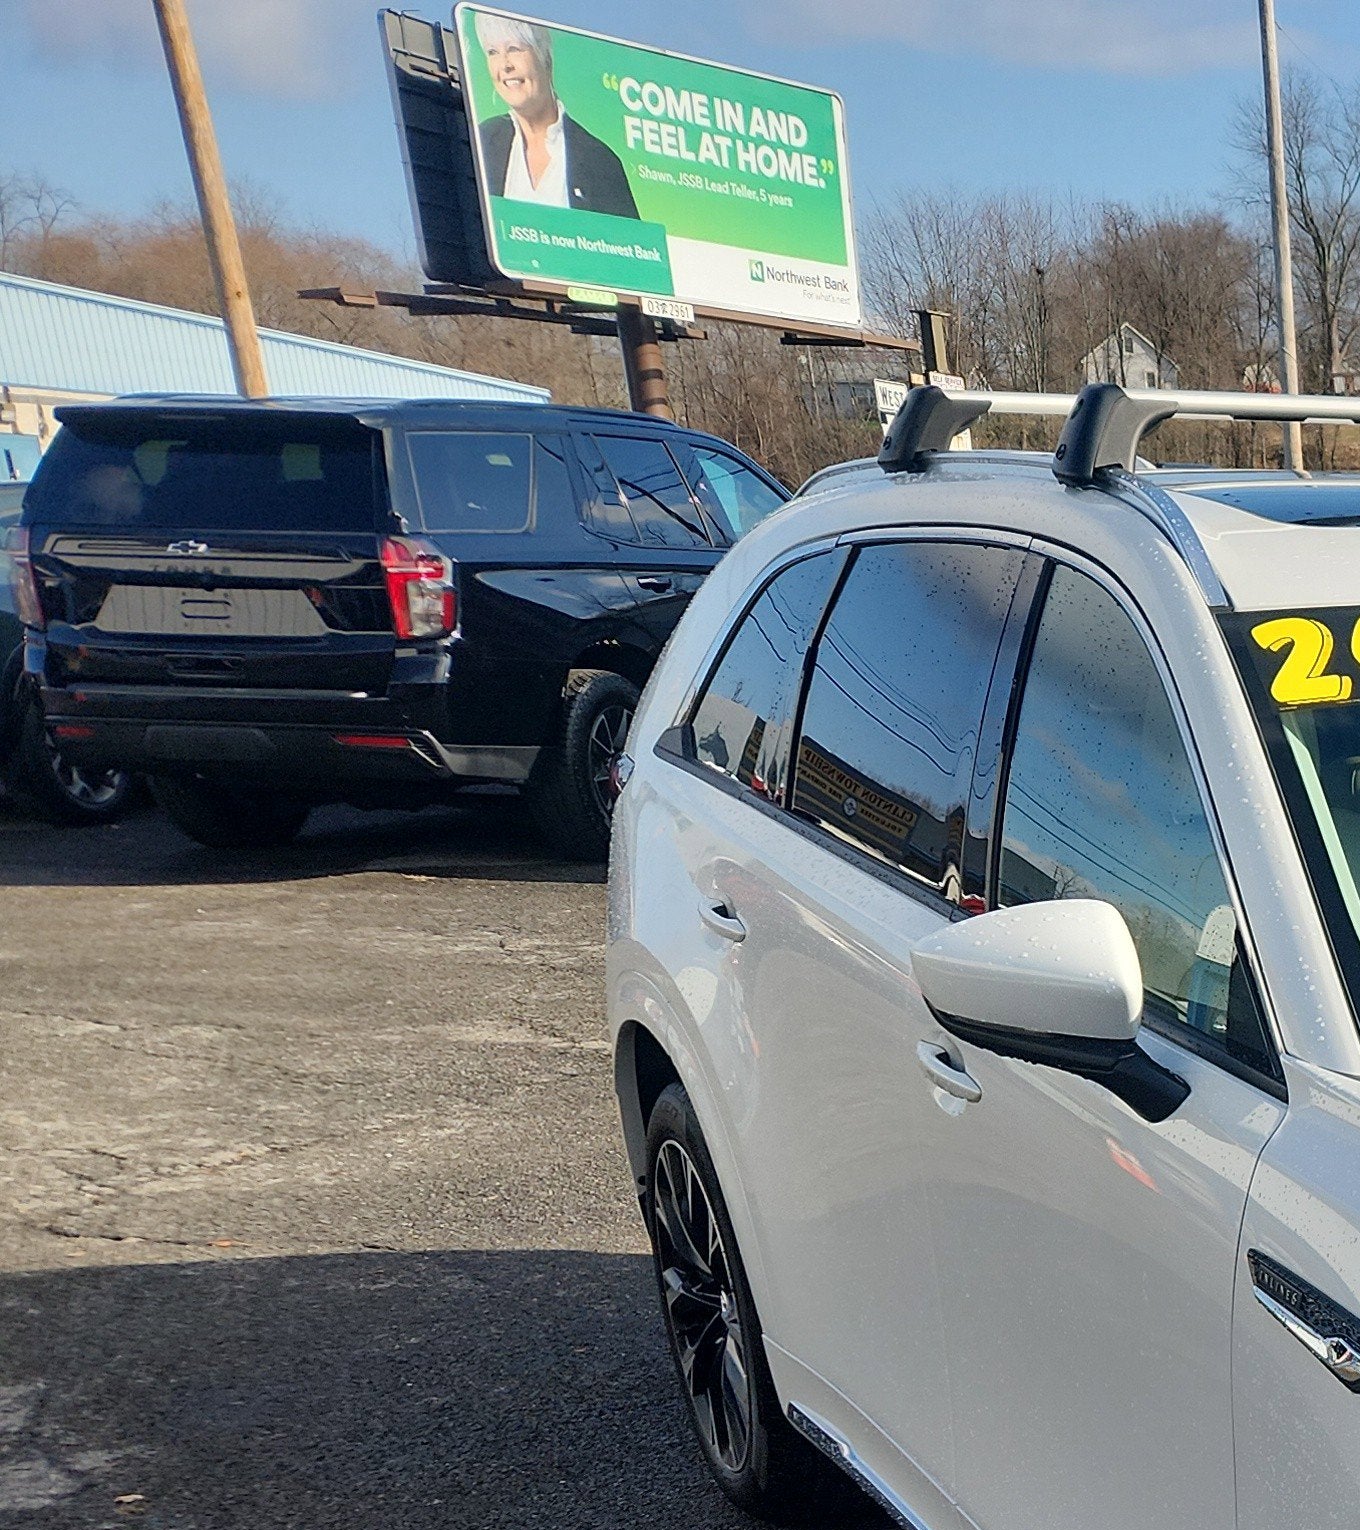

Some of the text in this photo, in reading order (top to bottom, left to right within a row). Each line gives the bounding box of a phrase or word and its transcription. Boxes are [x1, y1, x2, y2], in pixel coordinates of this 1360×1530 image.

[623, 115, 696, 162] FEEL
[697, 131, 732, 169] AT
[713, 96, 746, 136] IN
[749, 107, 808, 148] AND
[638, 164, 793, 207] Shawn, JSSB Lead Teller, 5 years
[508, 225, 662, 262] JSSB is now Northwest Bank
[766, 265, 849, 292] Northwest Bank
[880, 385, 904, 408] WEST
